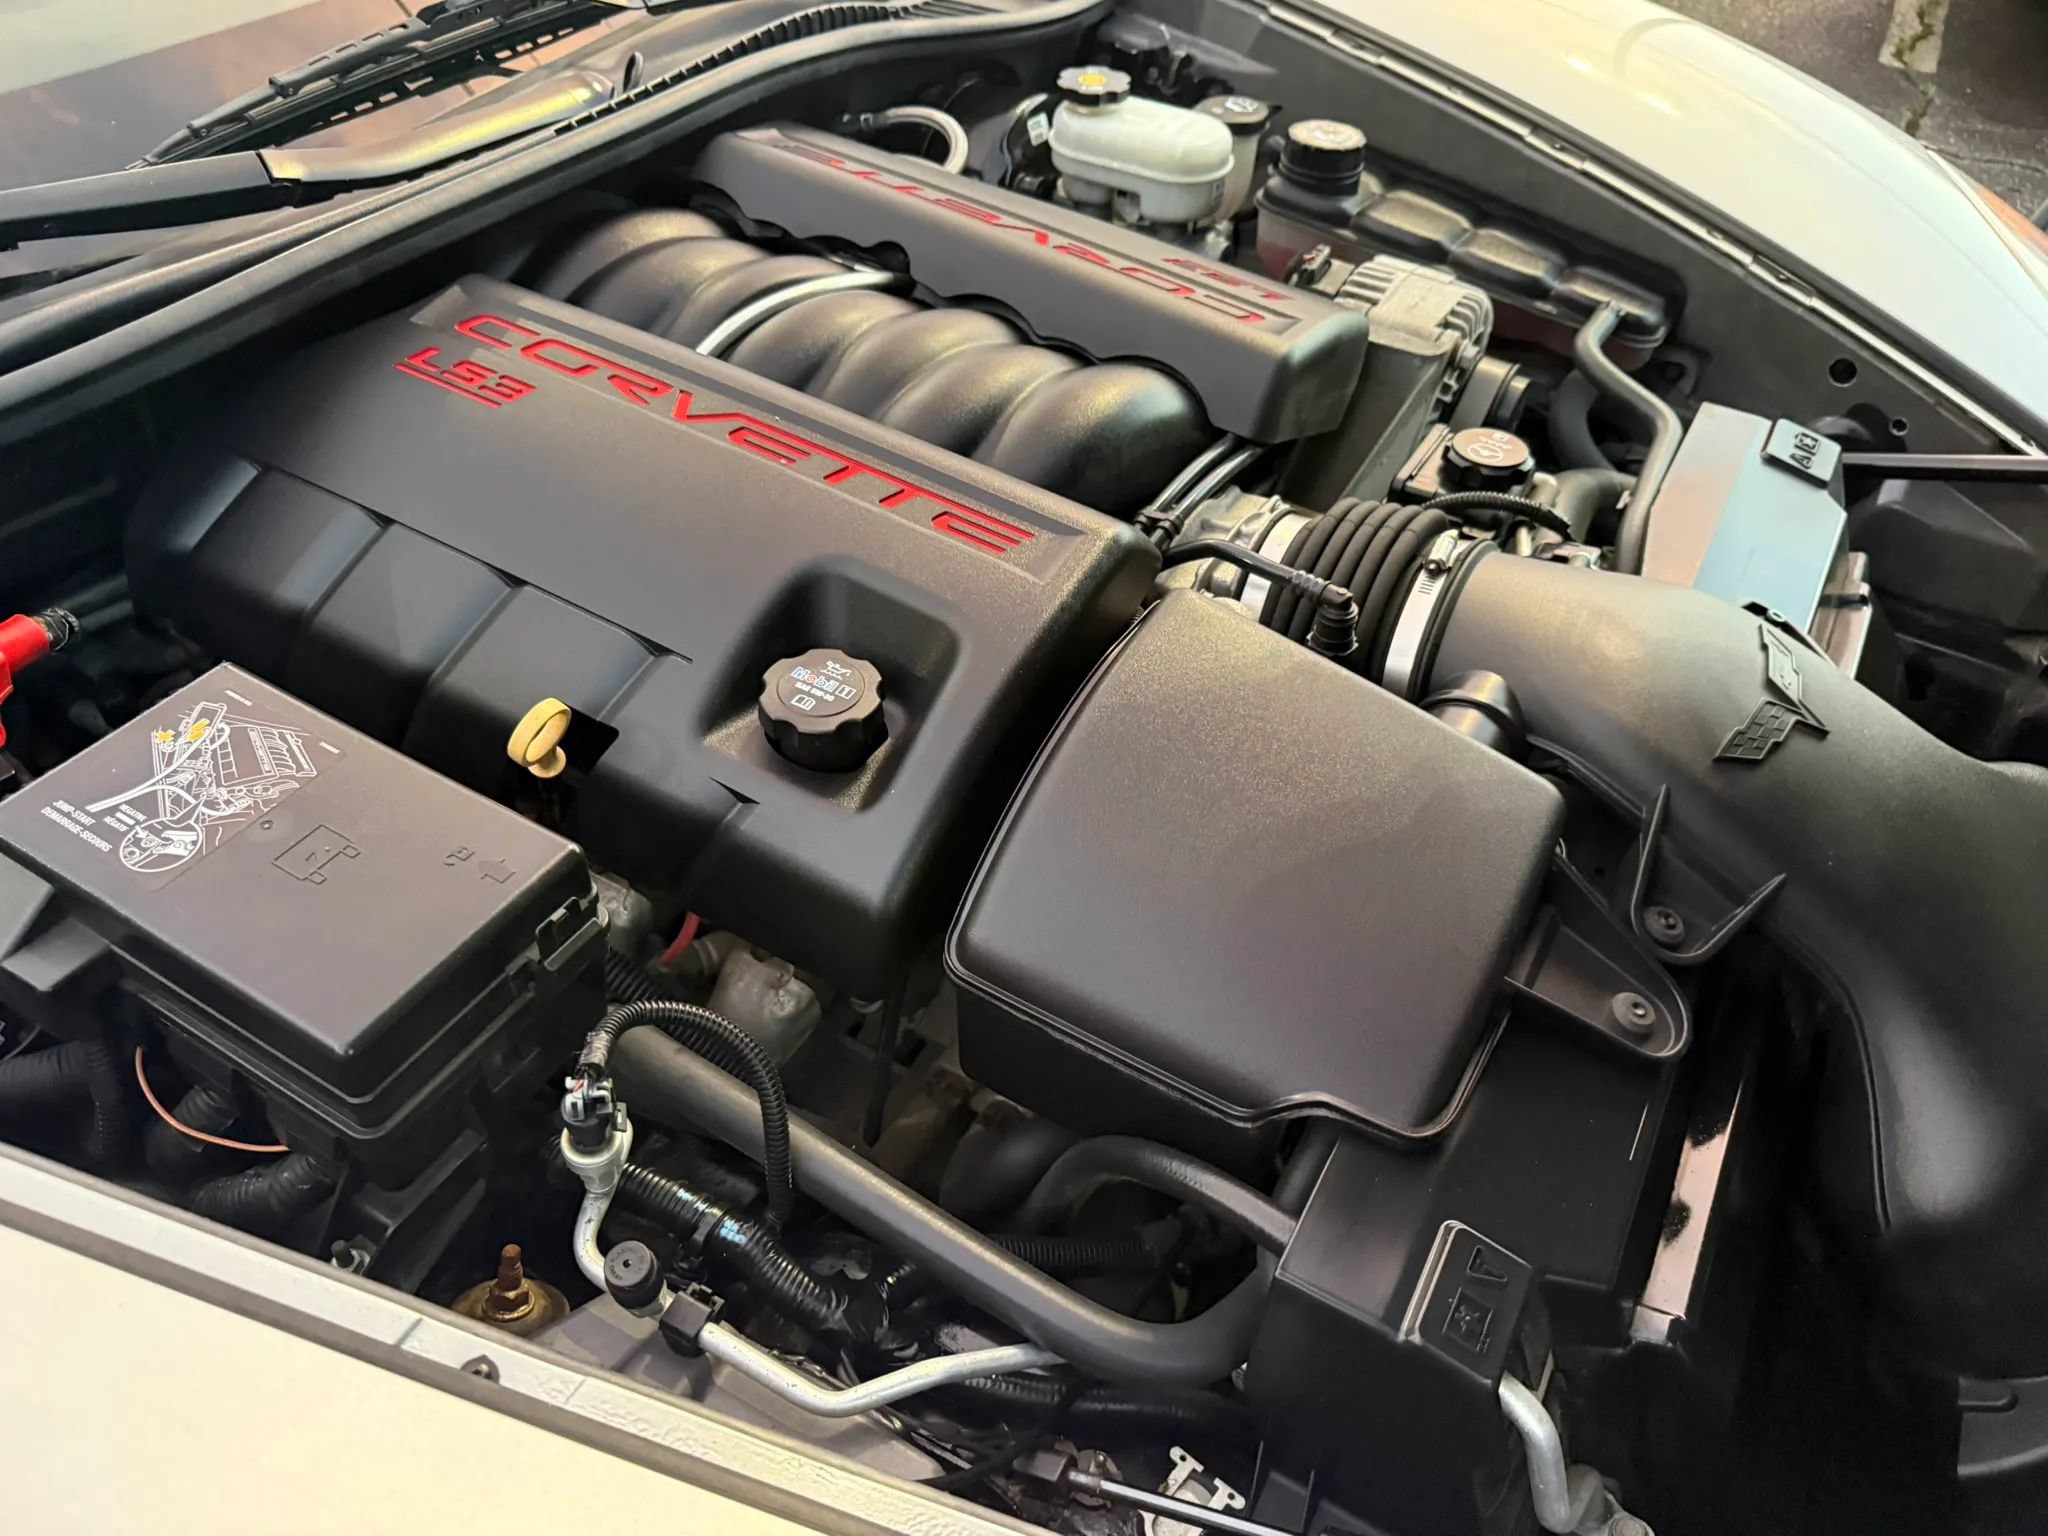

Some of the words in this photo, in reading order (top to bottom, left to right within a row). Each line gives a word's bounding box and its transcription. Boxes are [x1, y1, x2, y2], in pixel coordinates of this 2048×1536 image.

[773, 145, 1265, 326] CORVETTE
[398, 346, 537, 406] LS3
[454, 313, 1035, 554] CORVETTE
[791, 666, 839, 692] Mobil
[53, 800, 96, 826] JUMP-START
